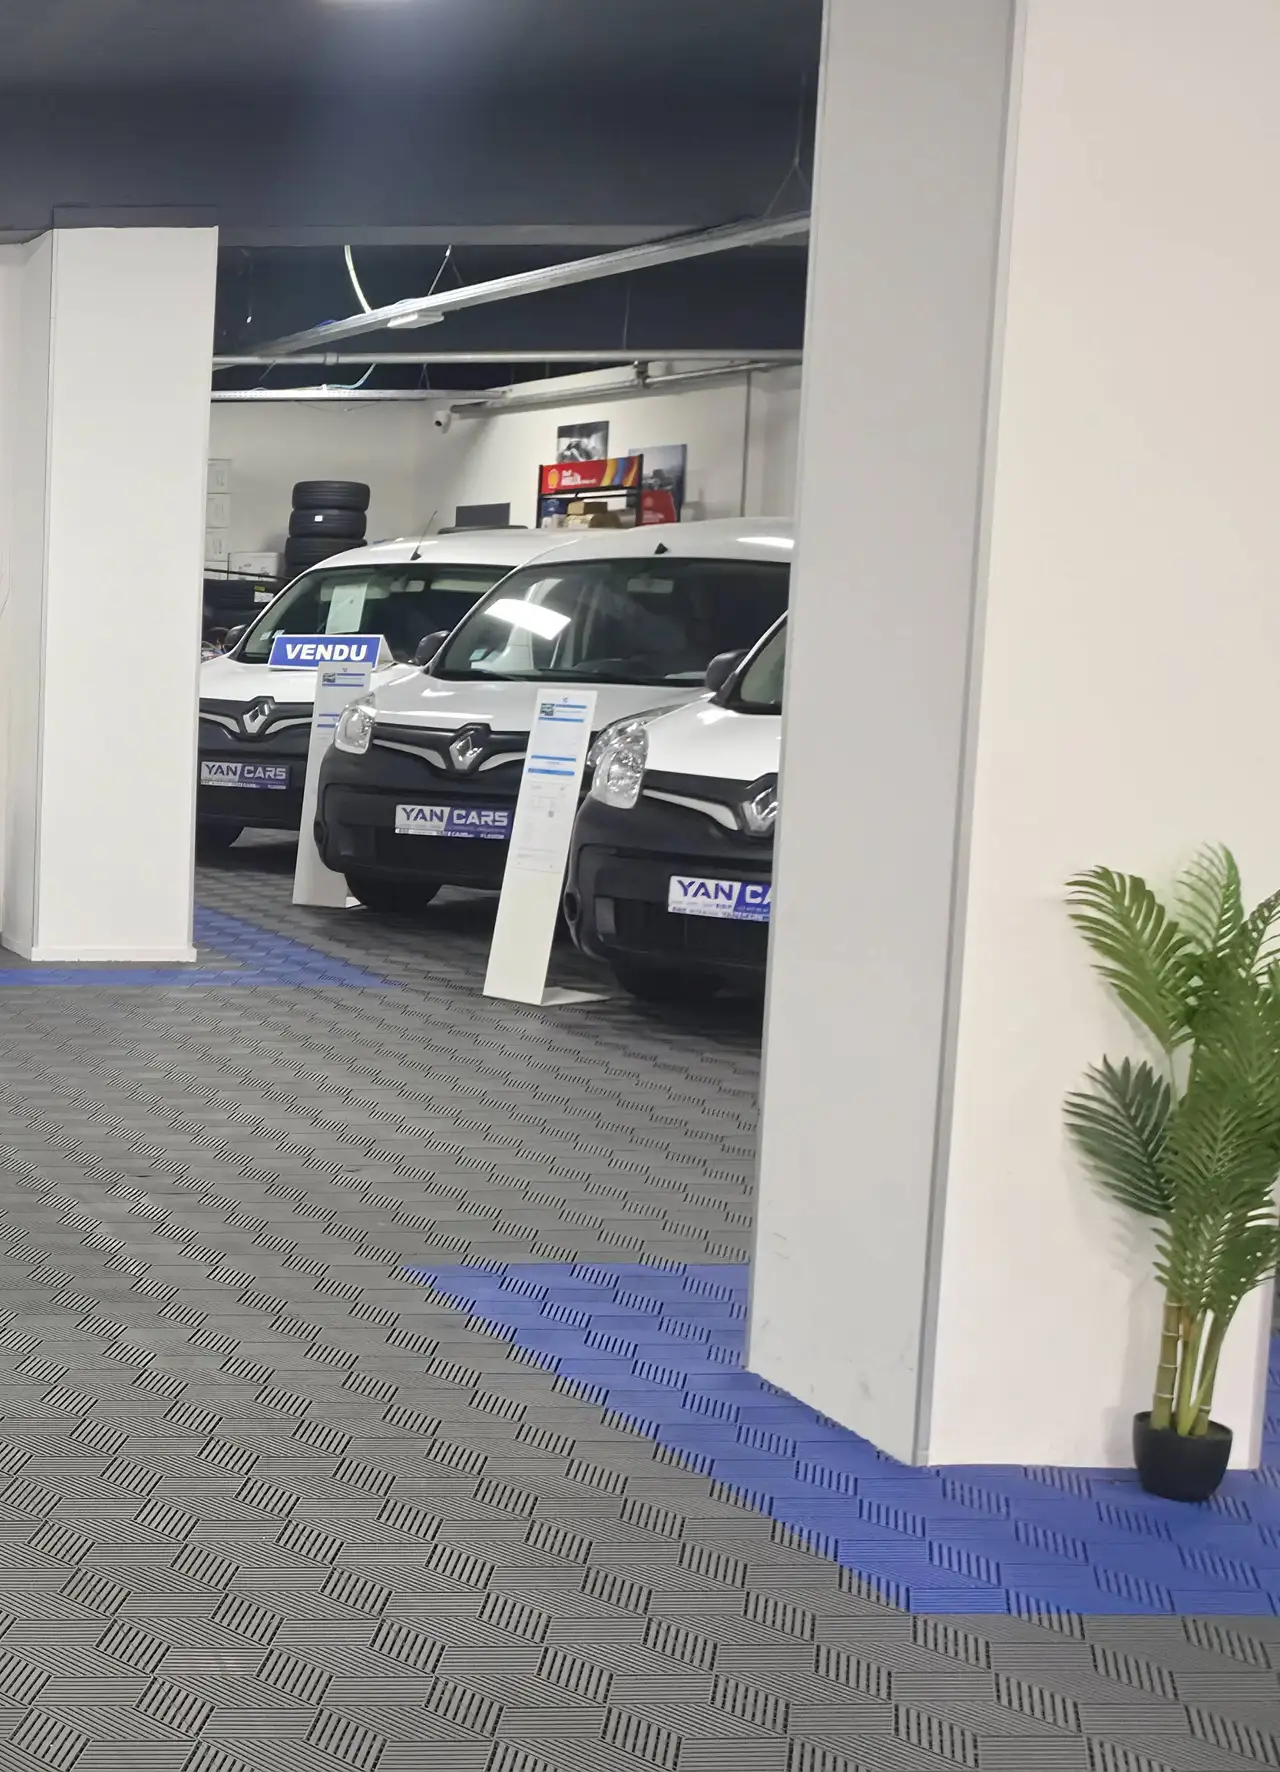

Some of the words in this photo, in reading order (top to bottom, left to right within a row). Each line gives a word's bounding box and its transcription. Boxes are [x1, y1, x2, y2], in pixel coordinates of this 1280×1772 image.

[285, 643, 368, 661] VENDU
[205, 764, 238, 777] YAN
[244, 765, 287, 780] CARS
[401, 807, 444, 823] YAN
[453, 809, 509, 826] CARS
[677, 880, 734, 901] YAN
